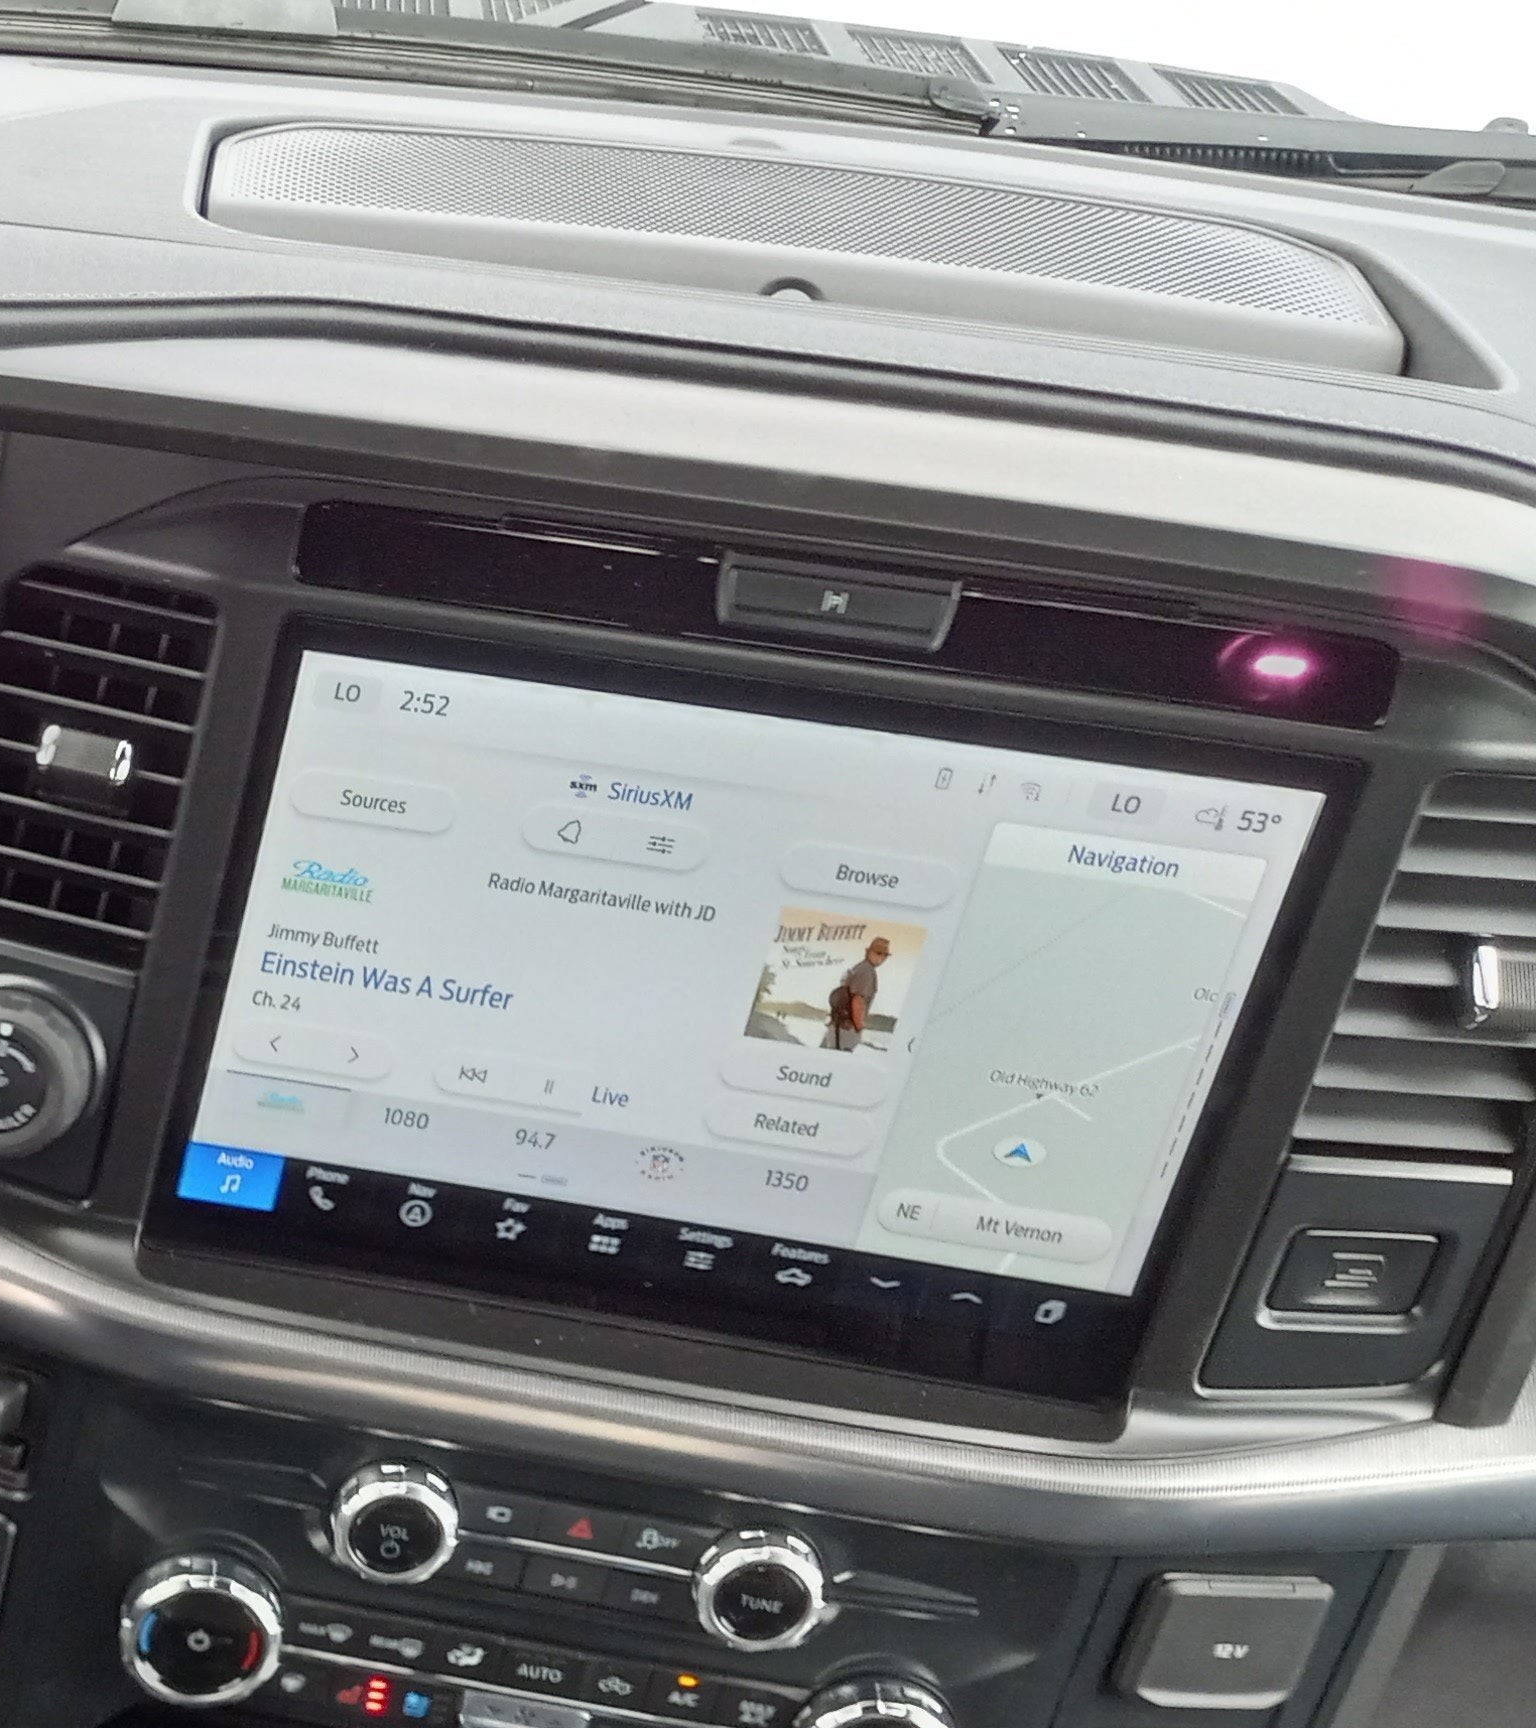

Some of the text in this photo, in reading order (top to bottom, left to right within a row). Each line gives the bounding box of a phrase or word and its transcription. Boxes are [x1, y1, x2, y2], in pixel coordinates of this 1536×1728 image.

[334, 681, 361, 703] LO
[399, 690, 451, 717] 2:52
[340, 789, 407, 815] Sources
[607, 782, 692, 811] SiriusXM
[1111, 793, 1283, 834] LO 53°
[1067, 844, 1180, 879] Navigation
[835, 863, 900, 889] Browse
[488, 873, 716, 923] Radio Margaritaville with JD
[267, 924, 380, 955] Jimmy Buffett
[260, 951, 514, 1011] Einstein Was A Surfer
[251, 990, 302, 1013] Ch. 24
[776, 1066, 833, 1088] Sound
[989, 1068, 1016, 1086] Old
[1018, 1072, 1077, 1098] Highway
[591, 1086, 629, 1108] Live
[383, 1107, 430, 1130] 1080
[753, 1112, 820, 1138] Related
[514, 1129, 557, 1151] 94.7
[217, 1152, 255, 1170] Audio
[764, 1169, 809, 1192] 1350
[896, 1202, 1064, 1246] NE Mt Vernon
[380, 1523, 410, 1543] VOL
[516, 1663, 564, 1684] AUTO
